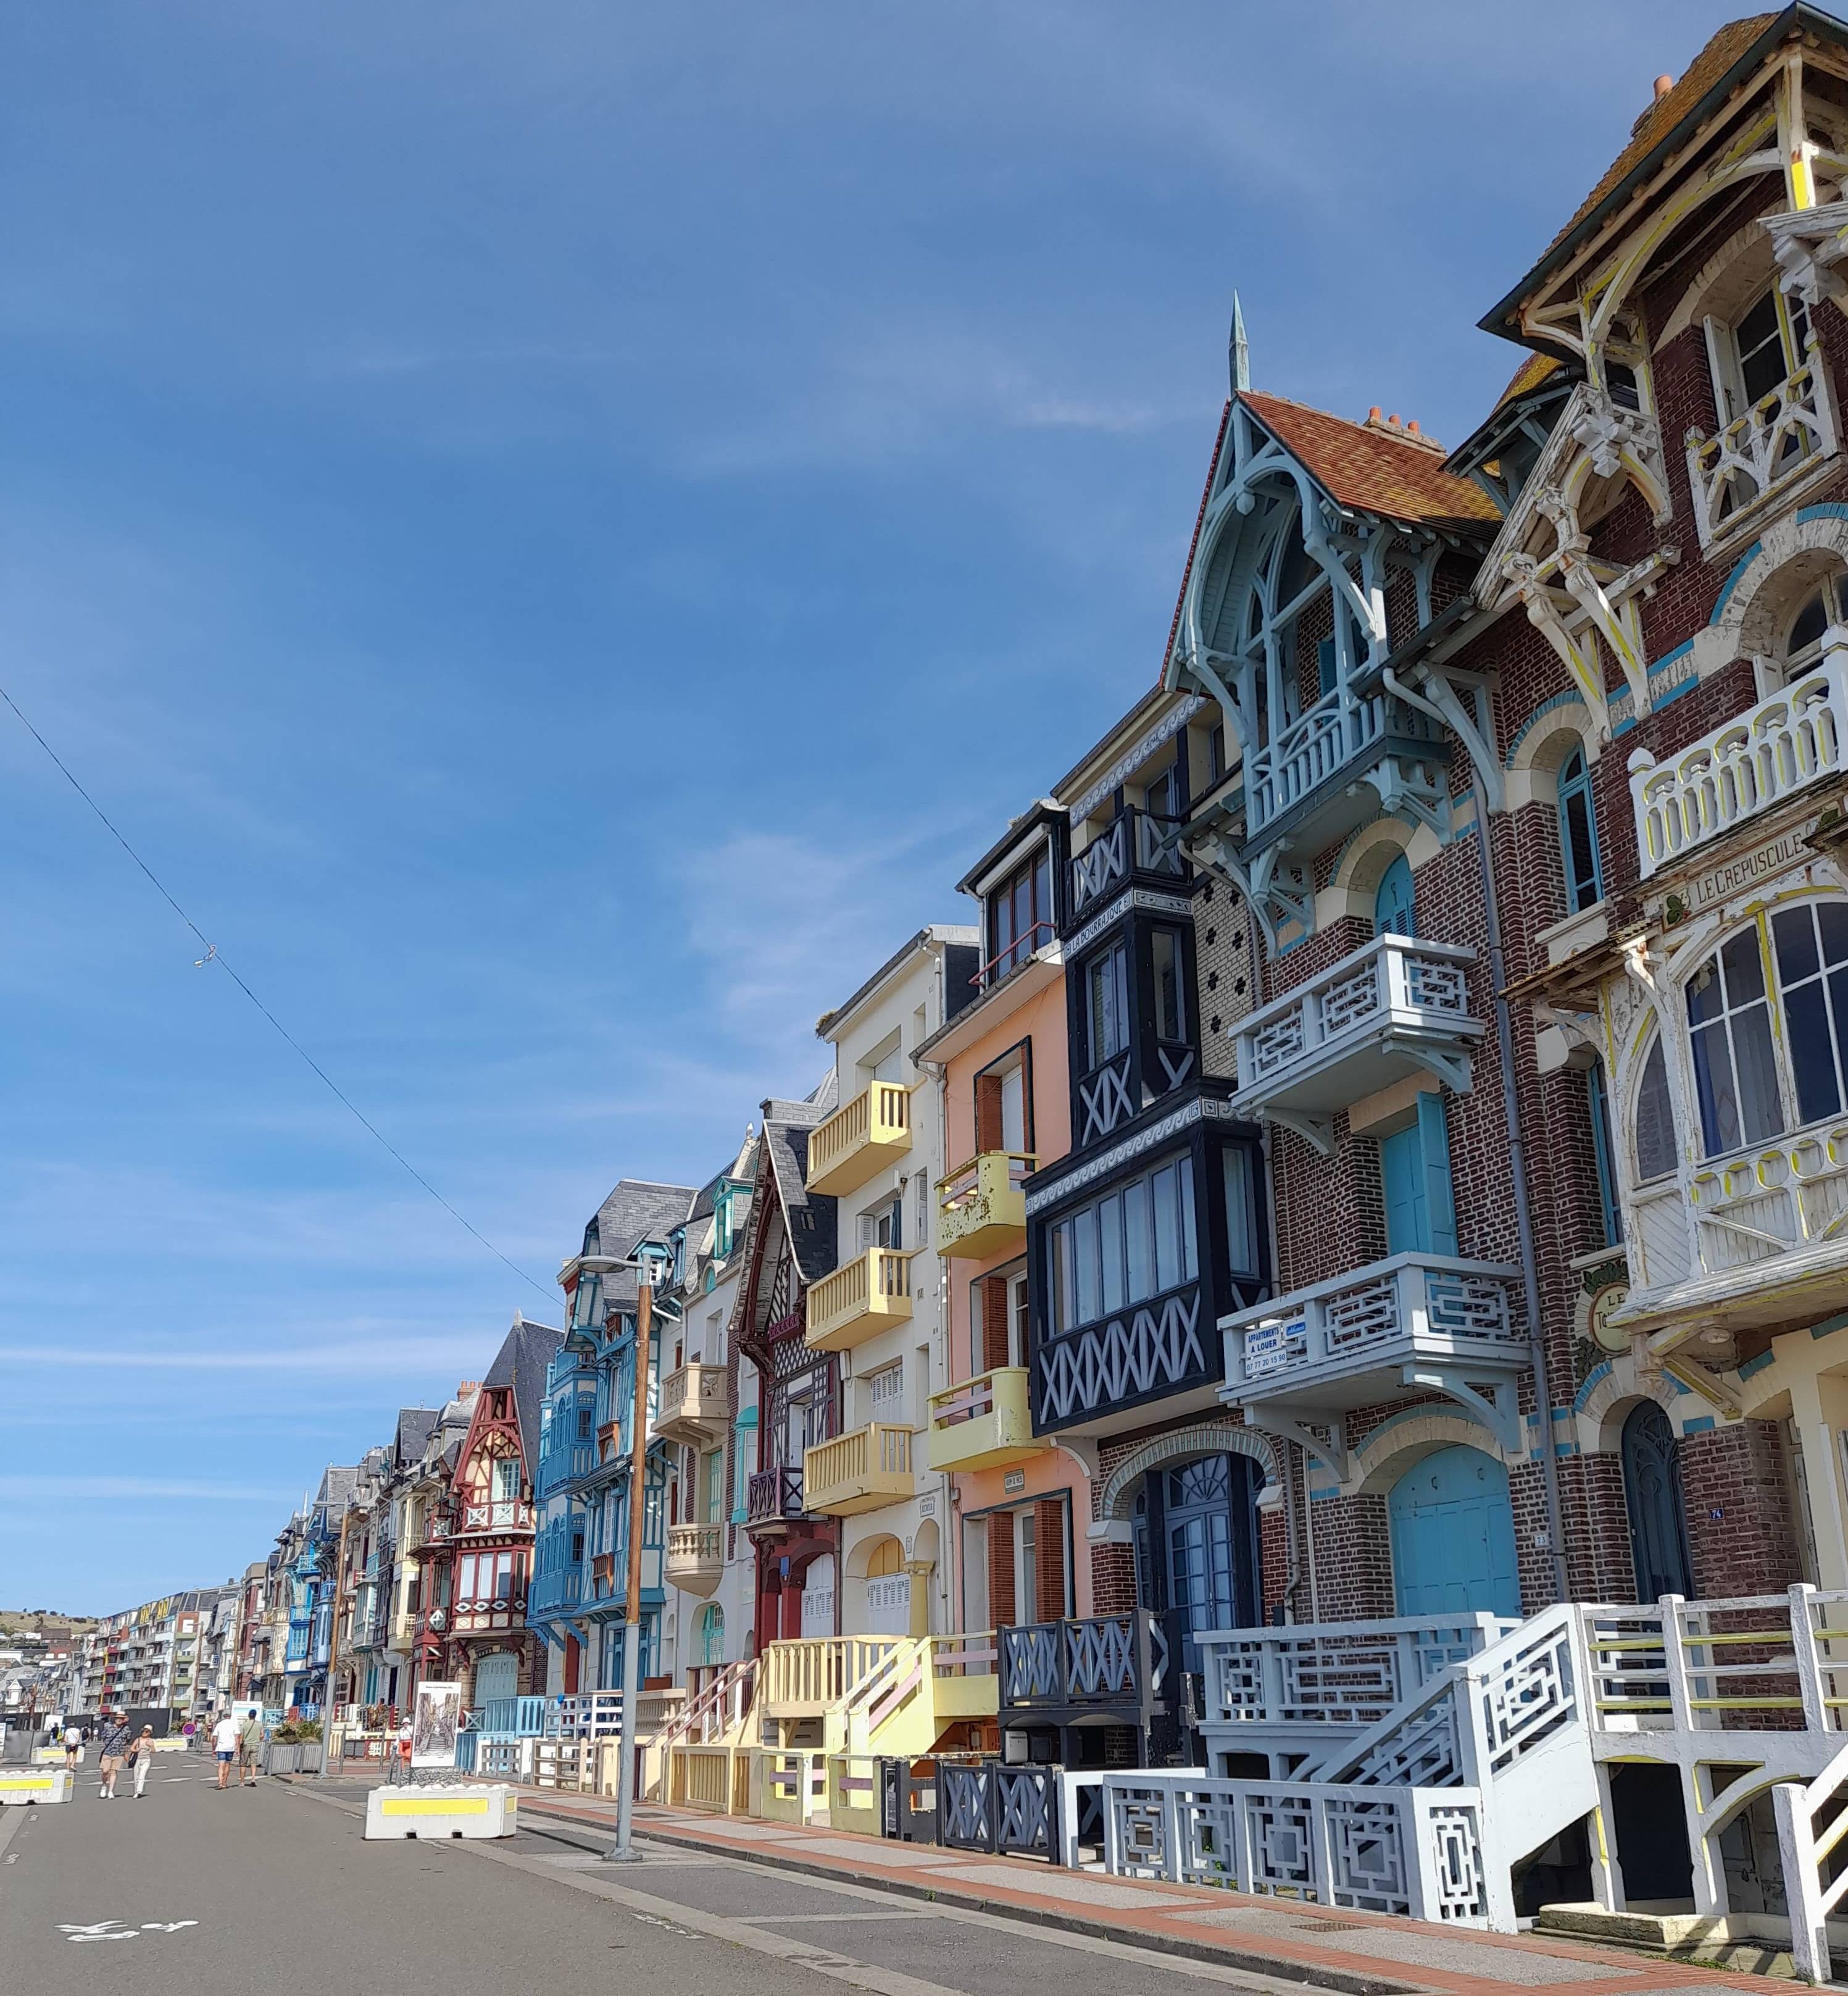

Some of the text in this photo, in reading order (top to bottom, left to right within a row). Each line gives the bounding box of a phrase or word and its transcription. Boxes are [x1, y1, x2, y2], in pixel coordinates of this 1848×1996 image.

[1697, 833, 1804, 904] LE CREPUSCULE
[1073, 936, 1080, 951] LA
[1607, 1293, 1625, 1306] LE
[1248, 1326, 1280, 1343] APPARTEMENTS
[1251, 1338, 1277, 1354] A LOUER
[1247, 1363, 1253, 1371] 07
[1255, 1360, 1261, 1368] 77
[1263, 1358, 1269, 1366] 20
[1279, 1353, 1286, 1361] 90
[1711, 1509, 1721, 1519] 74
